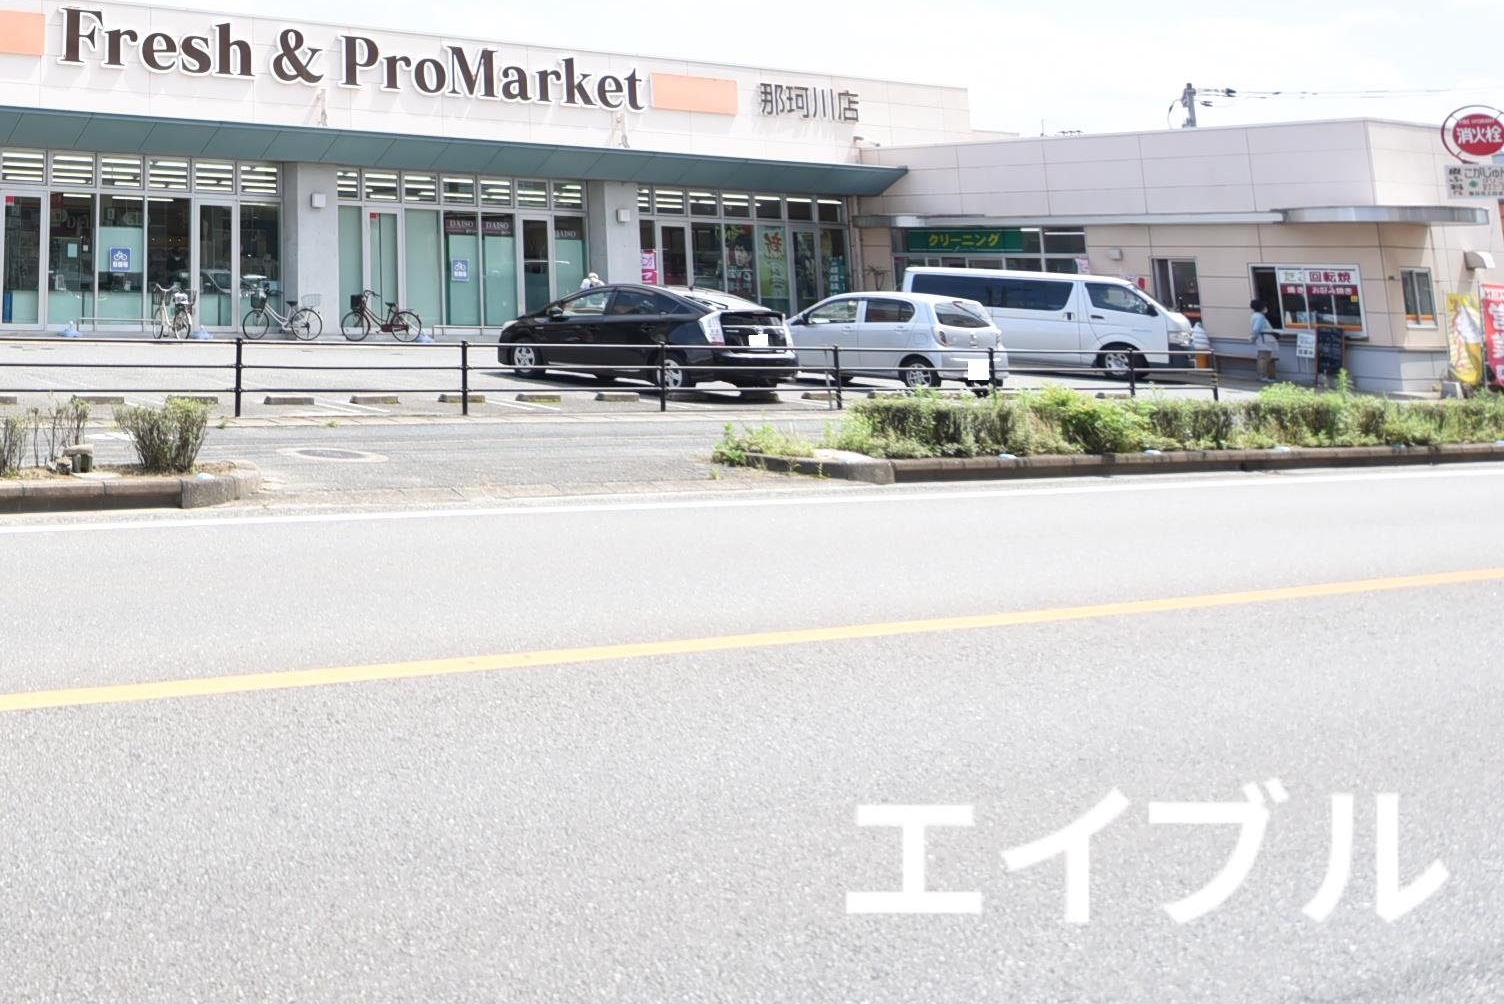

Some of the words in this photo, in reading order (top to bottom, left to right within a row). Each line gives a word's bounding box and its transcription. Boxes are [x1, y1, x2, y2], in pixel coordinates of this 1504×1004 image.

[58, 6, 254, 77] Fresh
[272, 28, 324, 84] &
[341, 35, 645, 110] ProMarket
[760, 82, 859, 122] 那珂川店
[1456, 126, 1503, 144] 消火栓
[449, 219, 474, 229] DAISO
[486, 222, 509, 230] DAISO
[928, 233, 1000, 246] クリーニング
